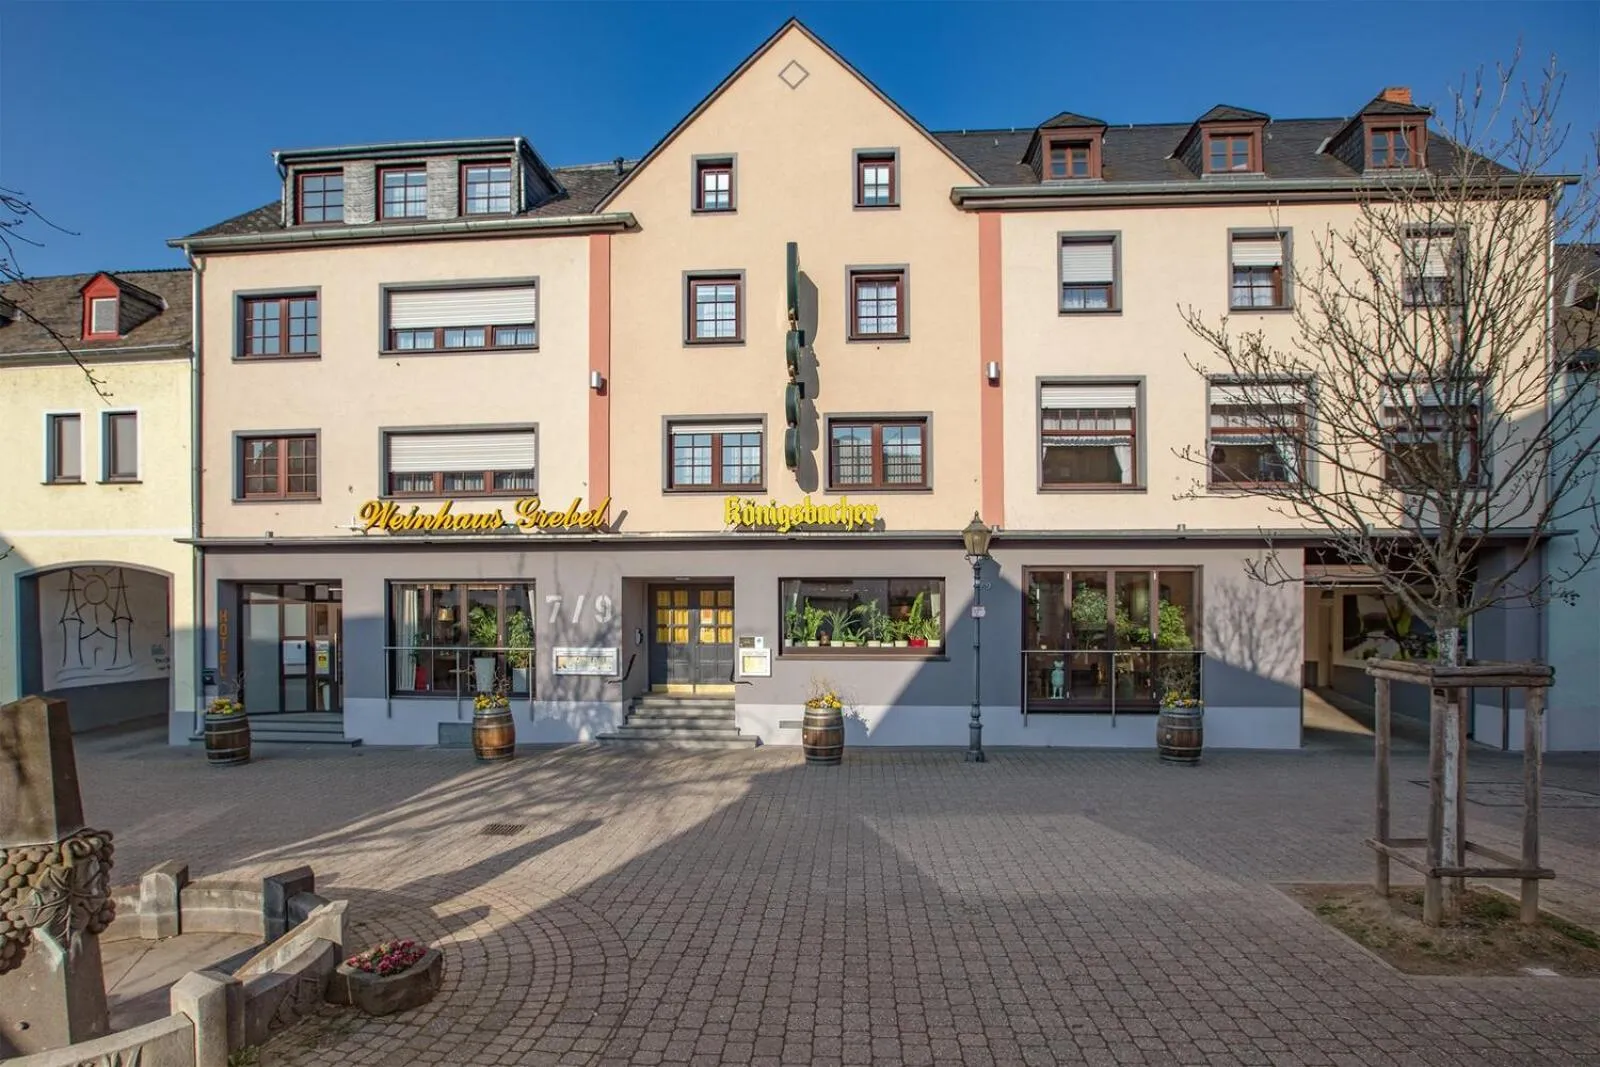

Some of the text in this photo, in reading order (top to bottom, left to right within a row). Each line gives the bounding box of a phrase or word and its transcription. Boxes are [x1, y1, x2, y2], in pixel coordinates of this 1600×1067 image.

[360, 496, 612, 531] Weinhaus Grebel
[724, 495, 878, 533] Königsbacher
[219, 608, 229, 677] HOTEL
